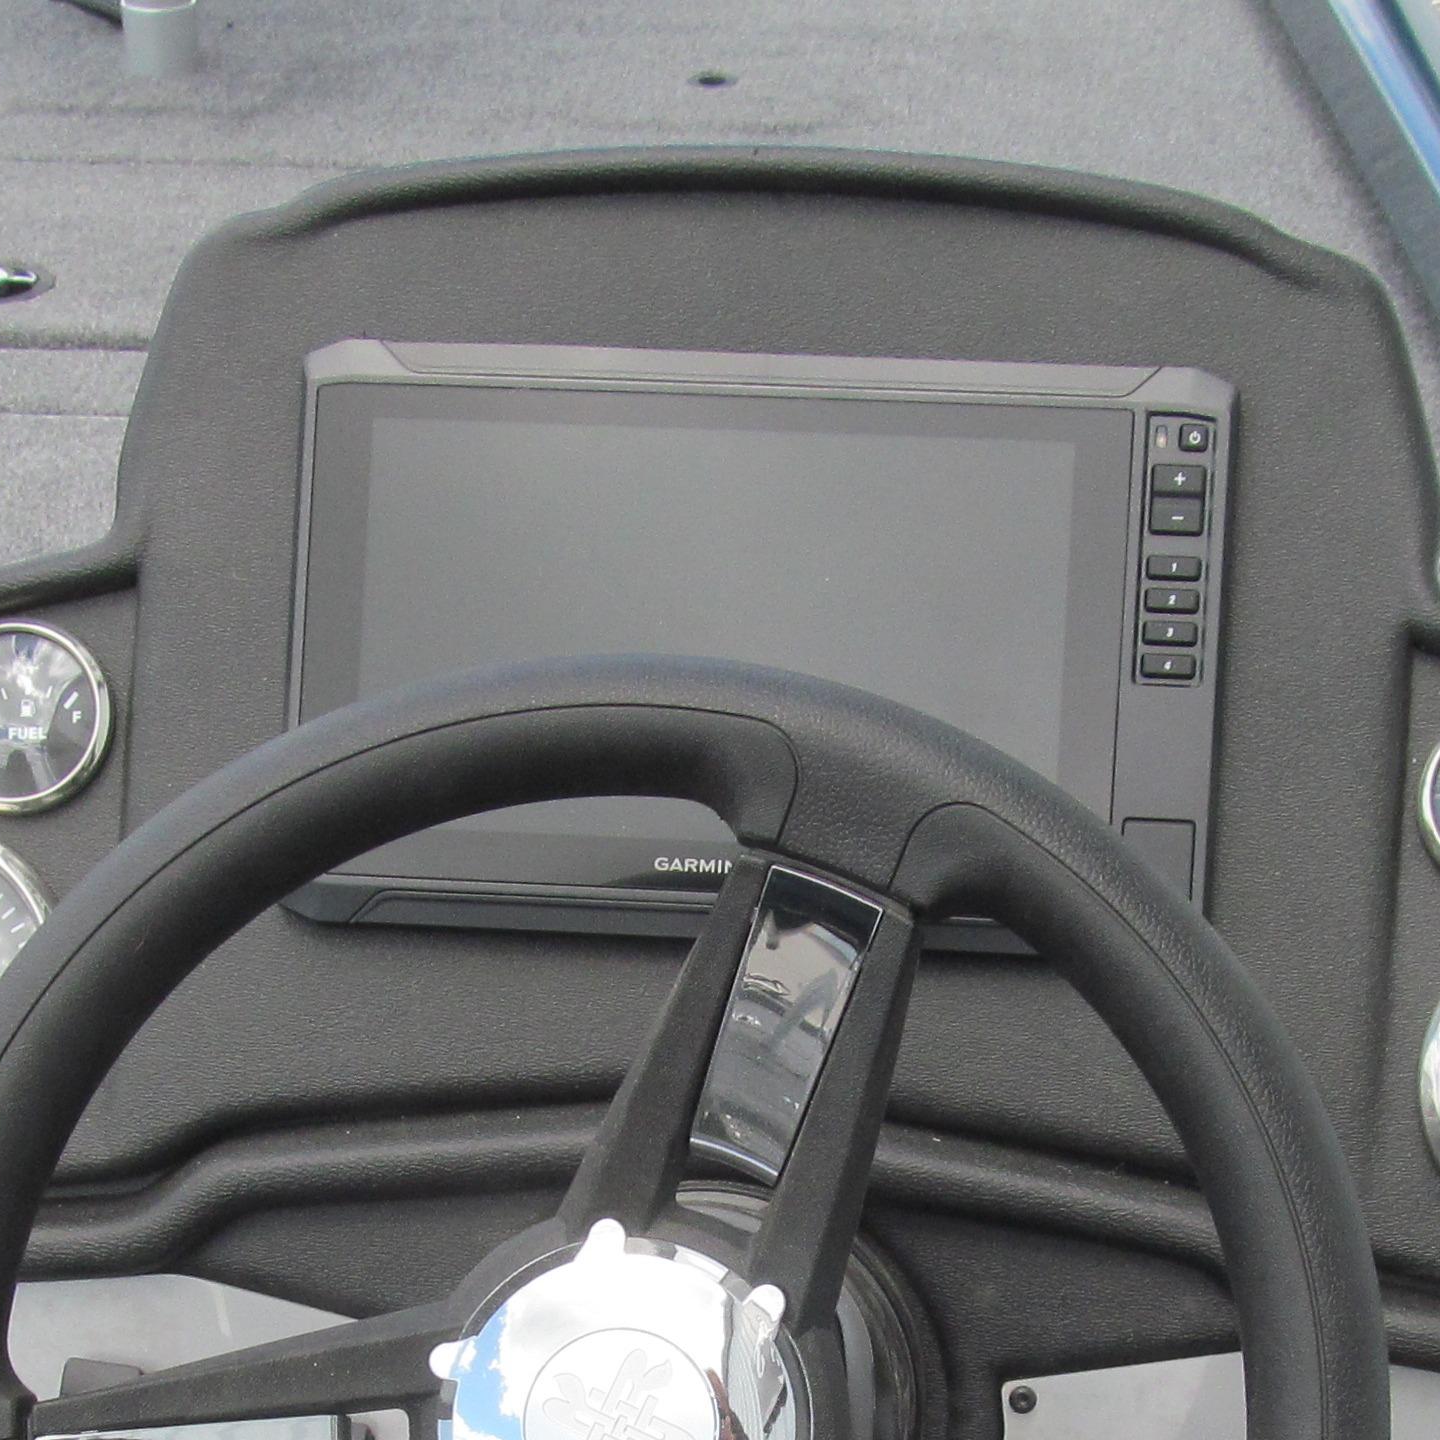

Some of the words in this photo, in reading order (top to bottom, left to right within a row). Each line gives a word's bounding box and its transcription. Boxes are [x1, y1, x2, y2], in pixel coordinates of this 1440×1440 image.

[1171, 562, 1177, 573] 1
[1168, 594, 1176, 605] 2
[1166, 627, 1174, 638] 3
[1163, 660, 1172, 671] 4
[72, 711, 81, 724] F
[8, 727, 48, 740] FUEL
